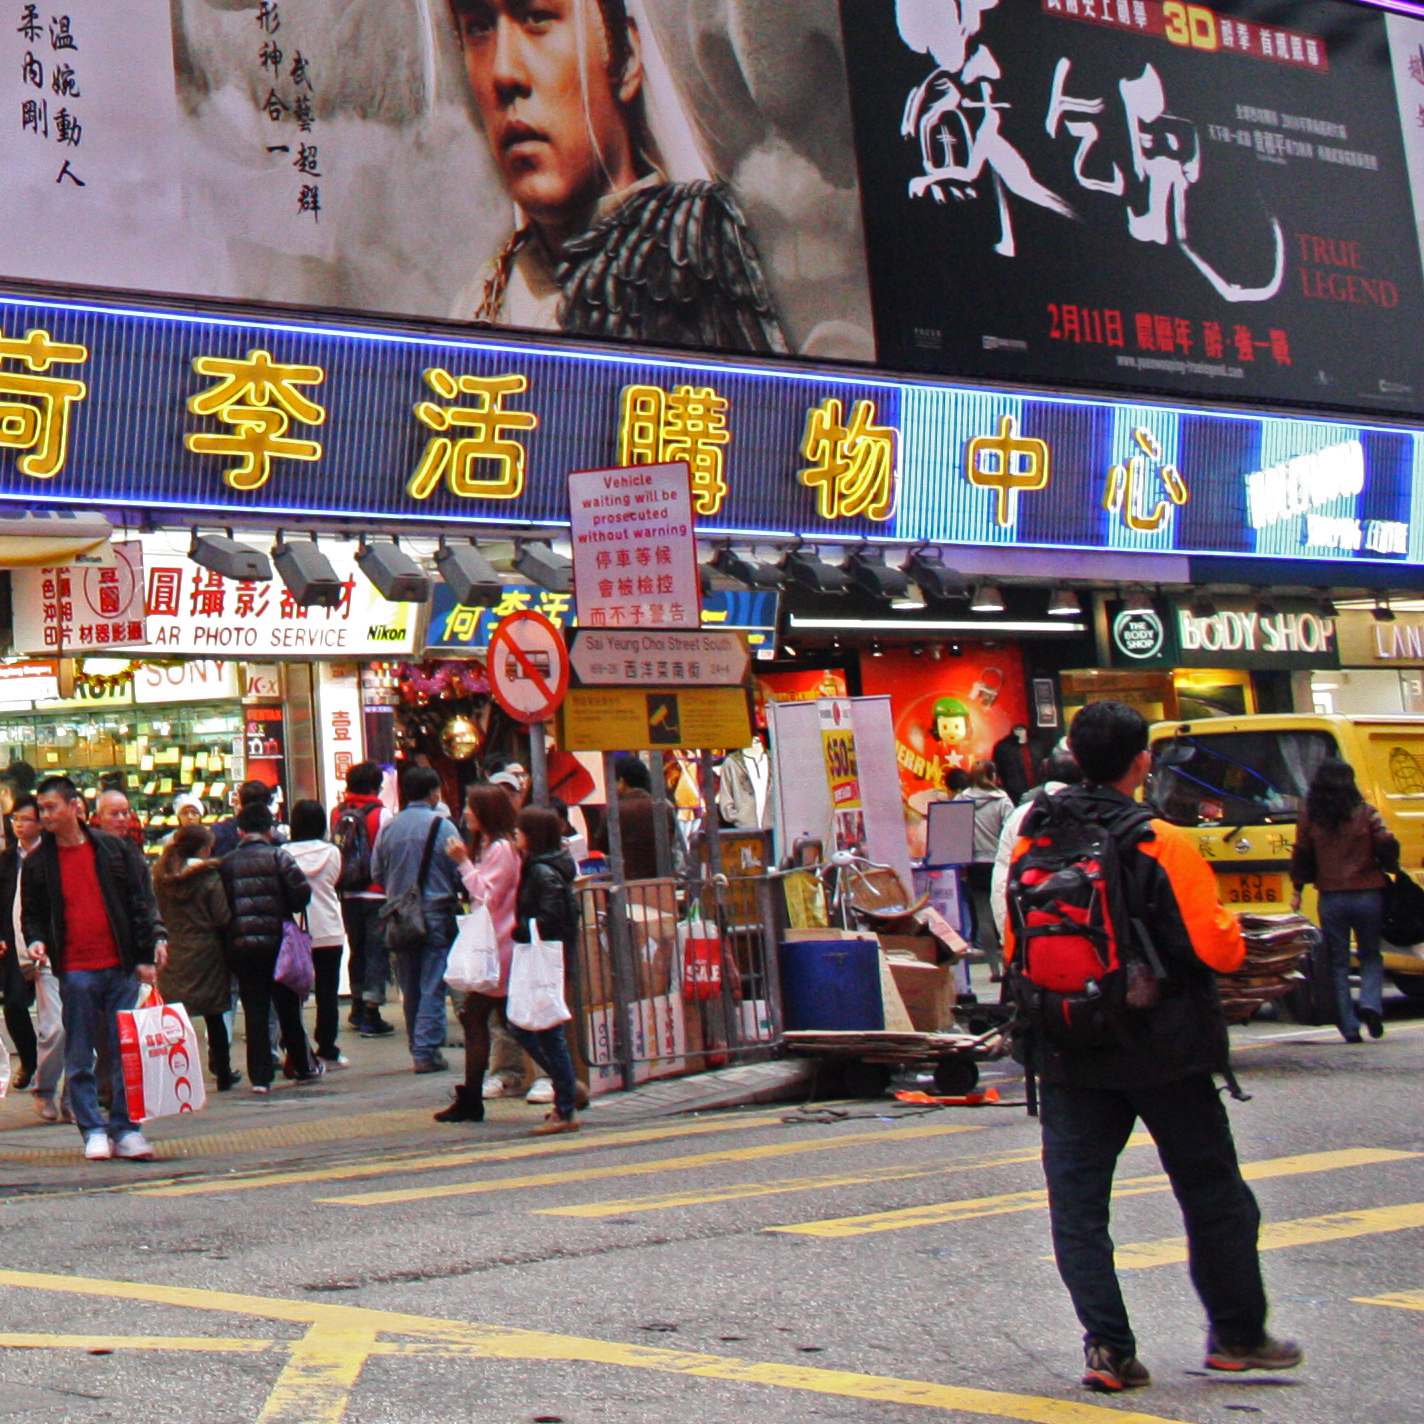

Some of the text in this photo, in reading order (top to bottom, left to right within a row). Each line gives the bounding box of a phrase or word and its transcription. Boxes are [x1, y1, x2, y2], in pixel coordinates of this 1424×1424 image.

[255, 1, 290, 154] 形神合一
[49, 14, 86, 187] 溫婉動人
[1294, 233, 1367, 270] TRUE
[1299, 269, 1400, 309] LEGEND
[1047, 303, 1125, 348] 2月11日
[603, 475, 653, 490] Vehicle
[582, 488, 679, 509] waiting will be
[592, 507, 669, 526] prosecuted
[577, 523, 687, 544] without warning
[595, 544, 673, 570] 停車等候
[597, 574, 675, 599] 會被檢控
[589, 602, 687, 627] 而不予警告
[1129, 621, 1148, 629] THE
[193, 624, 407, 648] PHOTO SERVICE Nikon
[1123, 629, 1155, 640] BODY
[1177, 609, 1334, 653] BODY SHOP
[586, 634, 733, 655] Sai Yeung Choi Street South
[1125, 638, 1155, 650] SHOP
[145, 659, 227, 688] SONY
[1230, 888, 1277, 903] 3646
